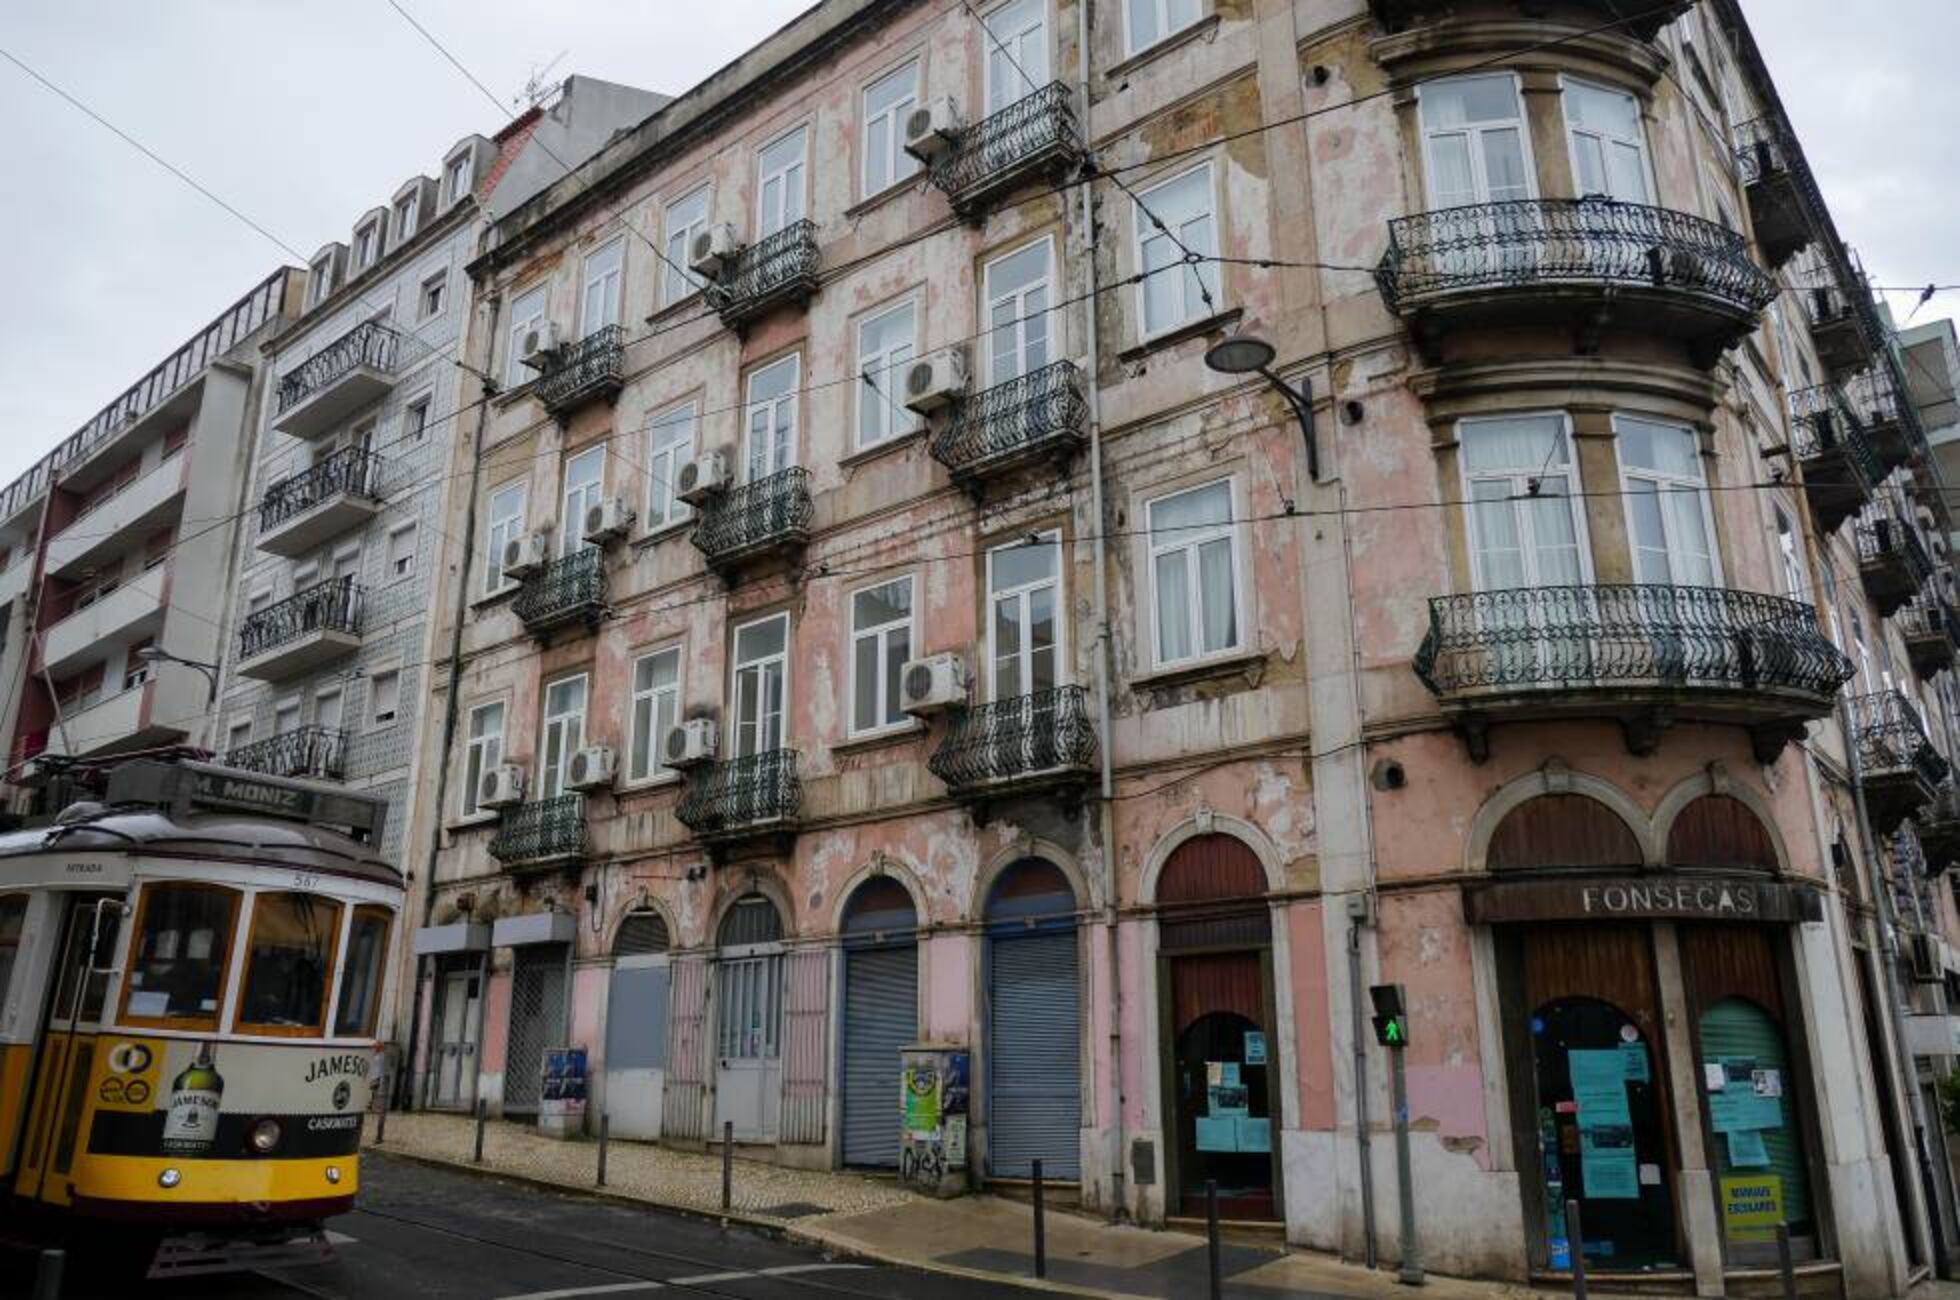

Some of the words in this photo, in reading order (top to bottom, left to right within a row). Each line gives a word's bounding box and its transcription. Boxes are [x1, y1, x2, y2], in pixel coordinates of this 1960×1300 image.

[224, 781, 297, 806] MONIZ
[1582, 885, 1753, 913] FONSECAS
[305, 1055, 369, 1083] JAMESO
